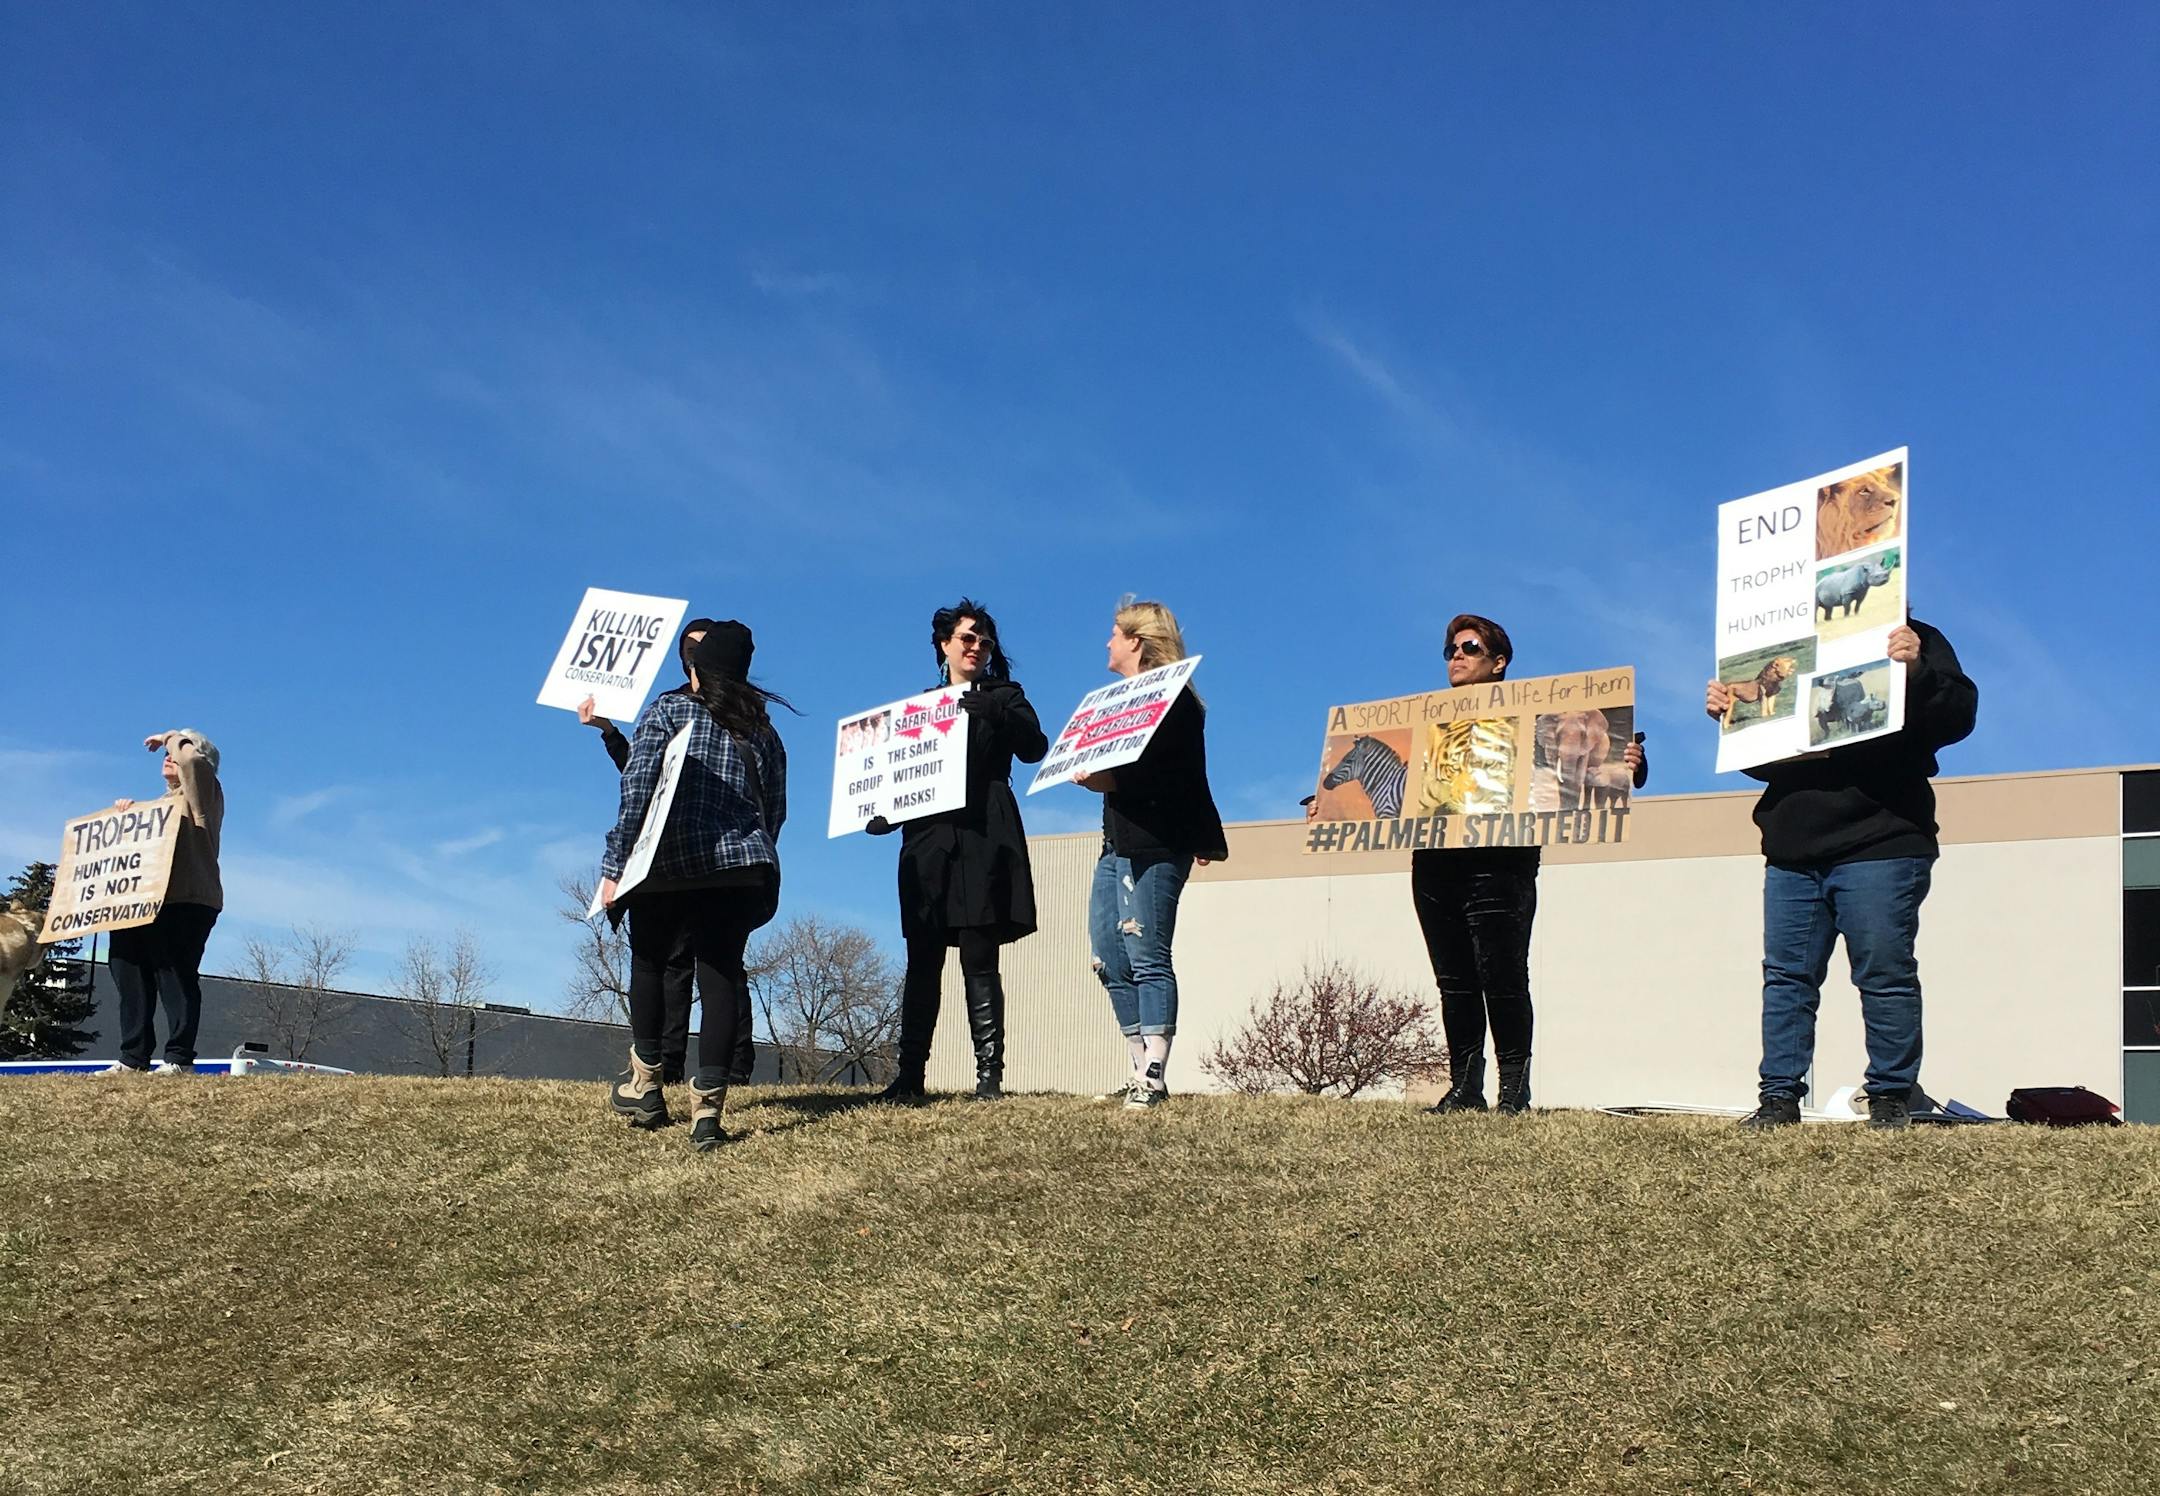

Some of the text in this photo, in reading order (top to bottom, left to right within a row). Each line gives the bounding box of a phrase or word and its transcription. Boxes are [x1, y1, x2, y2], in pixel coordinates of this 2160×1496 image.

[1737, 505, 1802, 545] END
[1730, 559, 1808, 594] TROPHY
[586, 609, 664, 640] KILLING
[1727, 601, 1809, 635] HUNTING
[570, 632, 653, 676] ISN'T
[565, 667, 637, 690] CONSERVATION
[1105, 681, 1134, 700] WAS
[1134, 669, 1168, 690] LEGAL
[1173, 663, 1190, 678] TO
[894, 703, 963, 732] SAFARI CLUB
[1094, 701, 1126, 721] THEIR
[1124, 688, 1168, 710] MOMS
[1330, 674, 1631, 731] A "SPORT" for you A life for them
[863, 738, 939, 771] IS THE SAME
[1036, 758, 1074, 782] WOULD
[1073, 749, 1092, 766] DO
[1089, 739, 1121, 762] THAT
[1051, 741, 1073, 758] THE
[848, 760, 944, 796] GROUP WITHOUT
[857, 787, 936, 819] THE MASKS!
[73, 804, 174, 856] TROPHY
[1306, 807, 1630, 853] #PALMER STARTED IT
[73, 852, 142, 882] HUNTING
[80, 876, 142, 902] IS NOT
[51, 899, 162, 932] CONSERVATION
